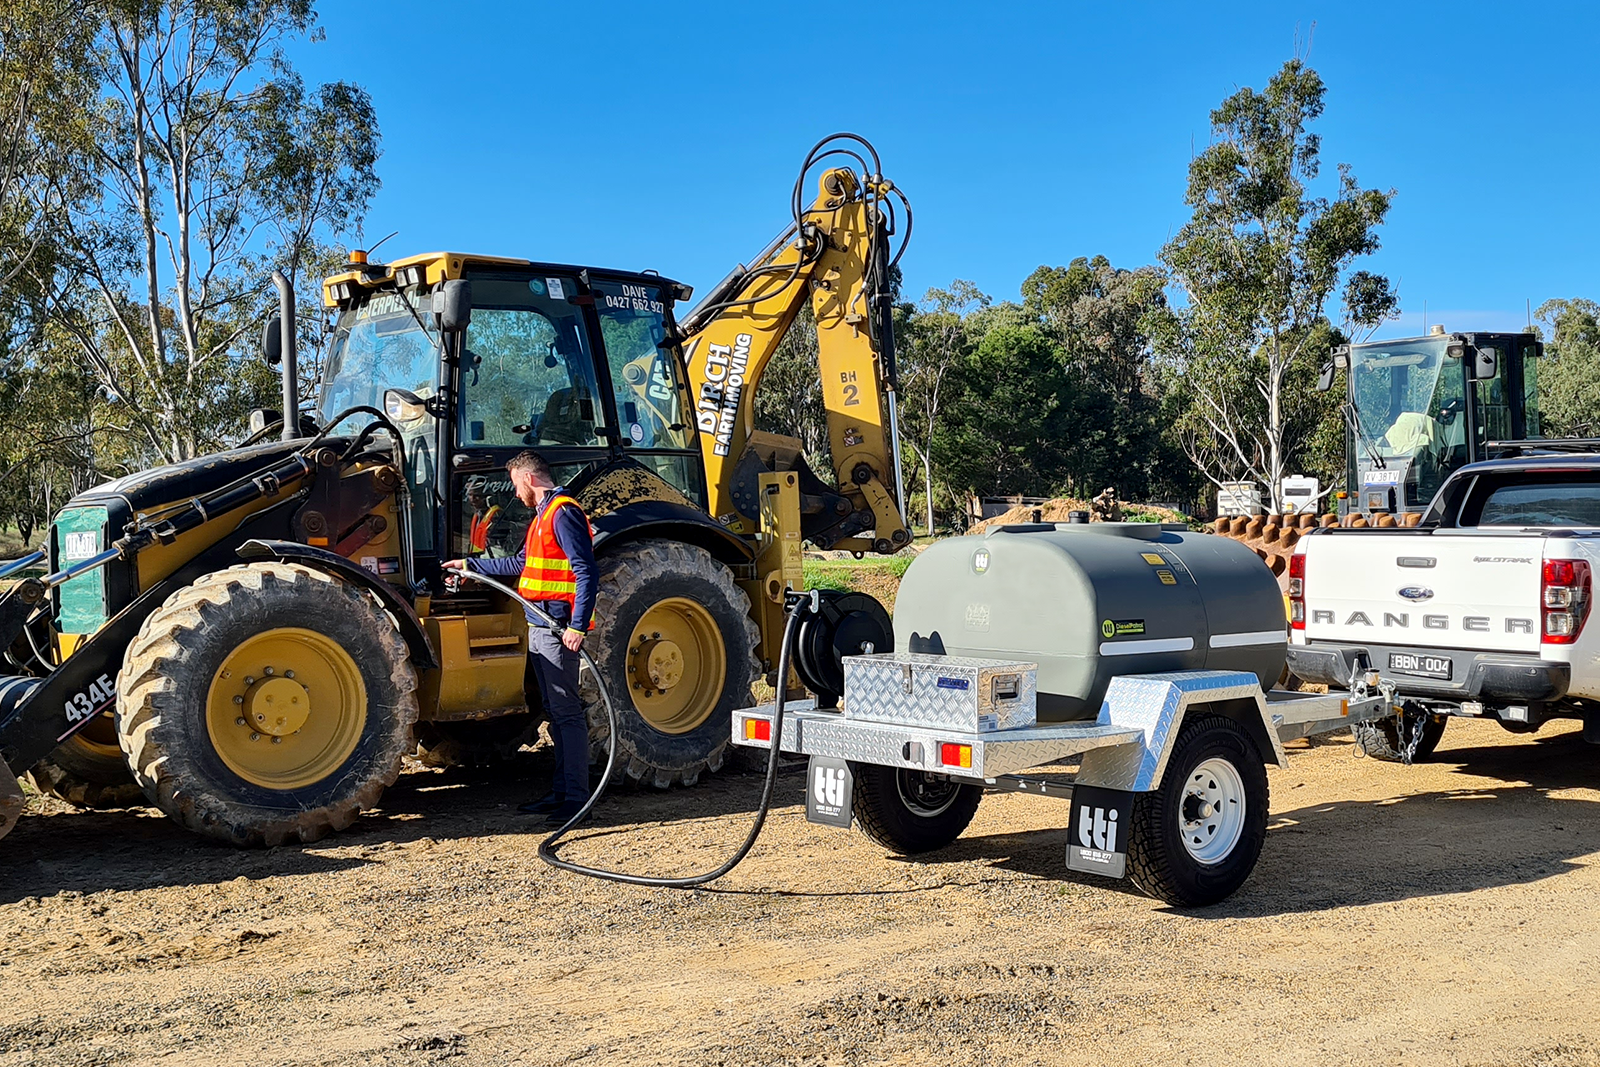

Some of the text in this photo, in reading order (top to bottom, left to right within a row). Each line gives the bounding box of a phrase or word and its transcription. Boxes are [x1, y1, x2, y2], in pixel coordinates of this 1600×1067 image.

[606, 296, 664, 314] 0427 662 927
[622, 285, 647, 299] DAVE
[696, 342, 731, 436] BIRCH
[840, 370, 857, 383] BH
[713, 333, 752, 457] EARTHMOVING
[843, 384, 859, 406] 2
[1312, 610, 1534, 634] RANGER
[64, 673, 116, 722] 434E
[814, 766, 845, 807] tti
[1078, 805, 1119, 852] tti
